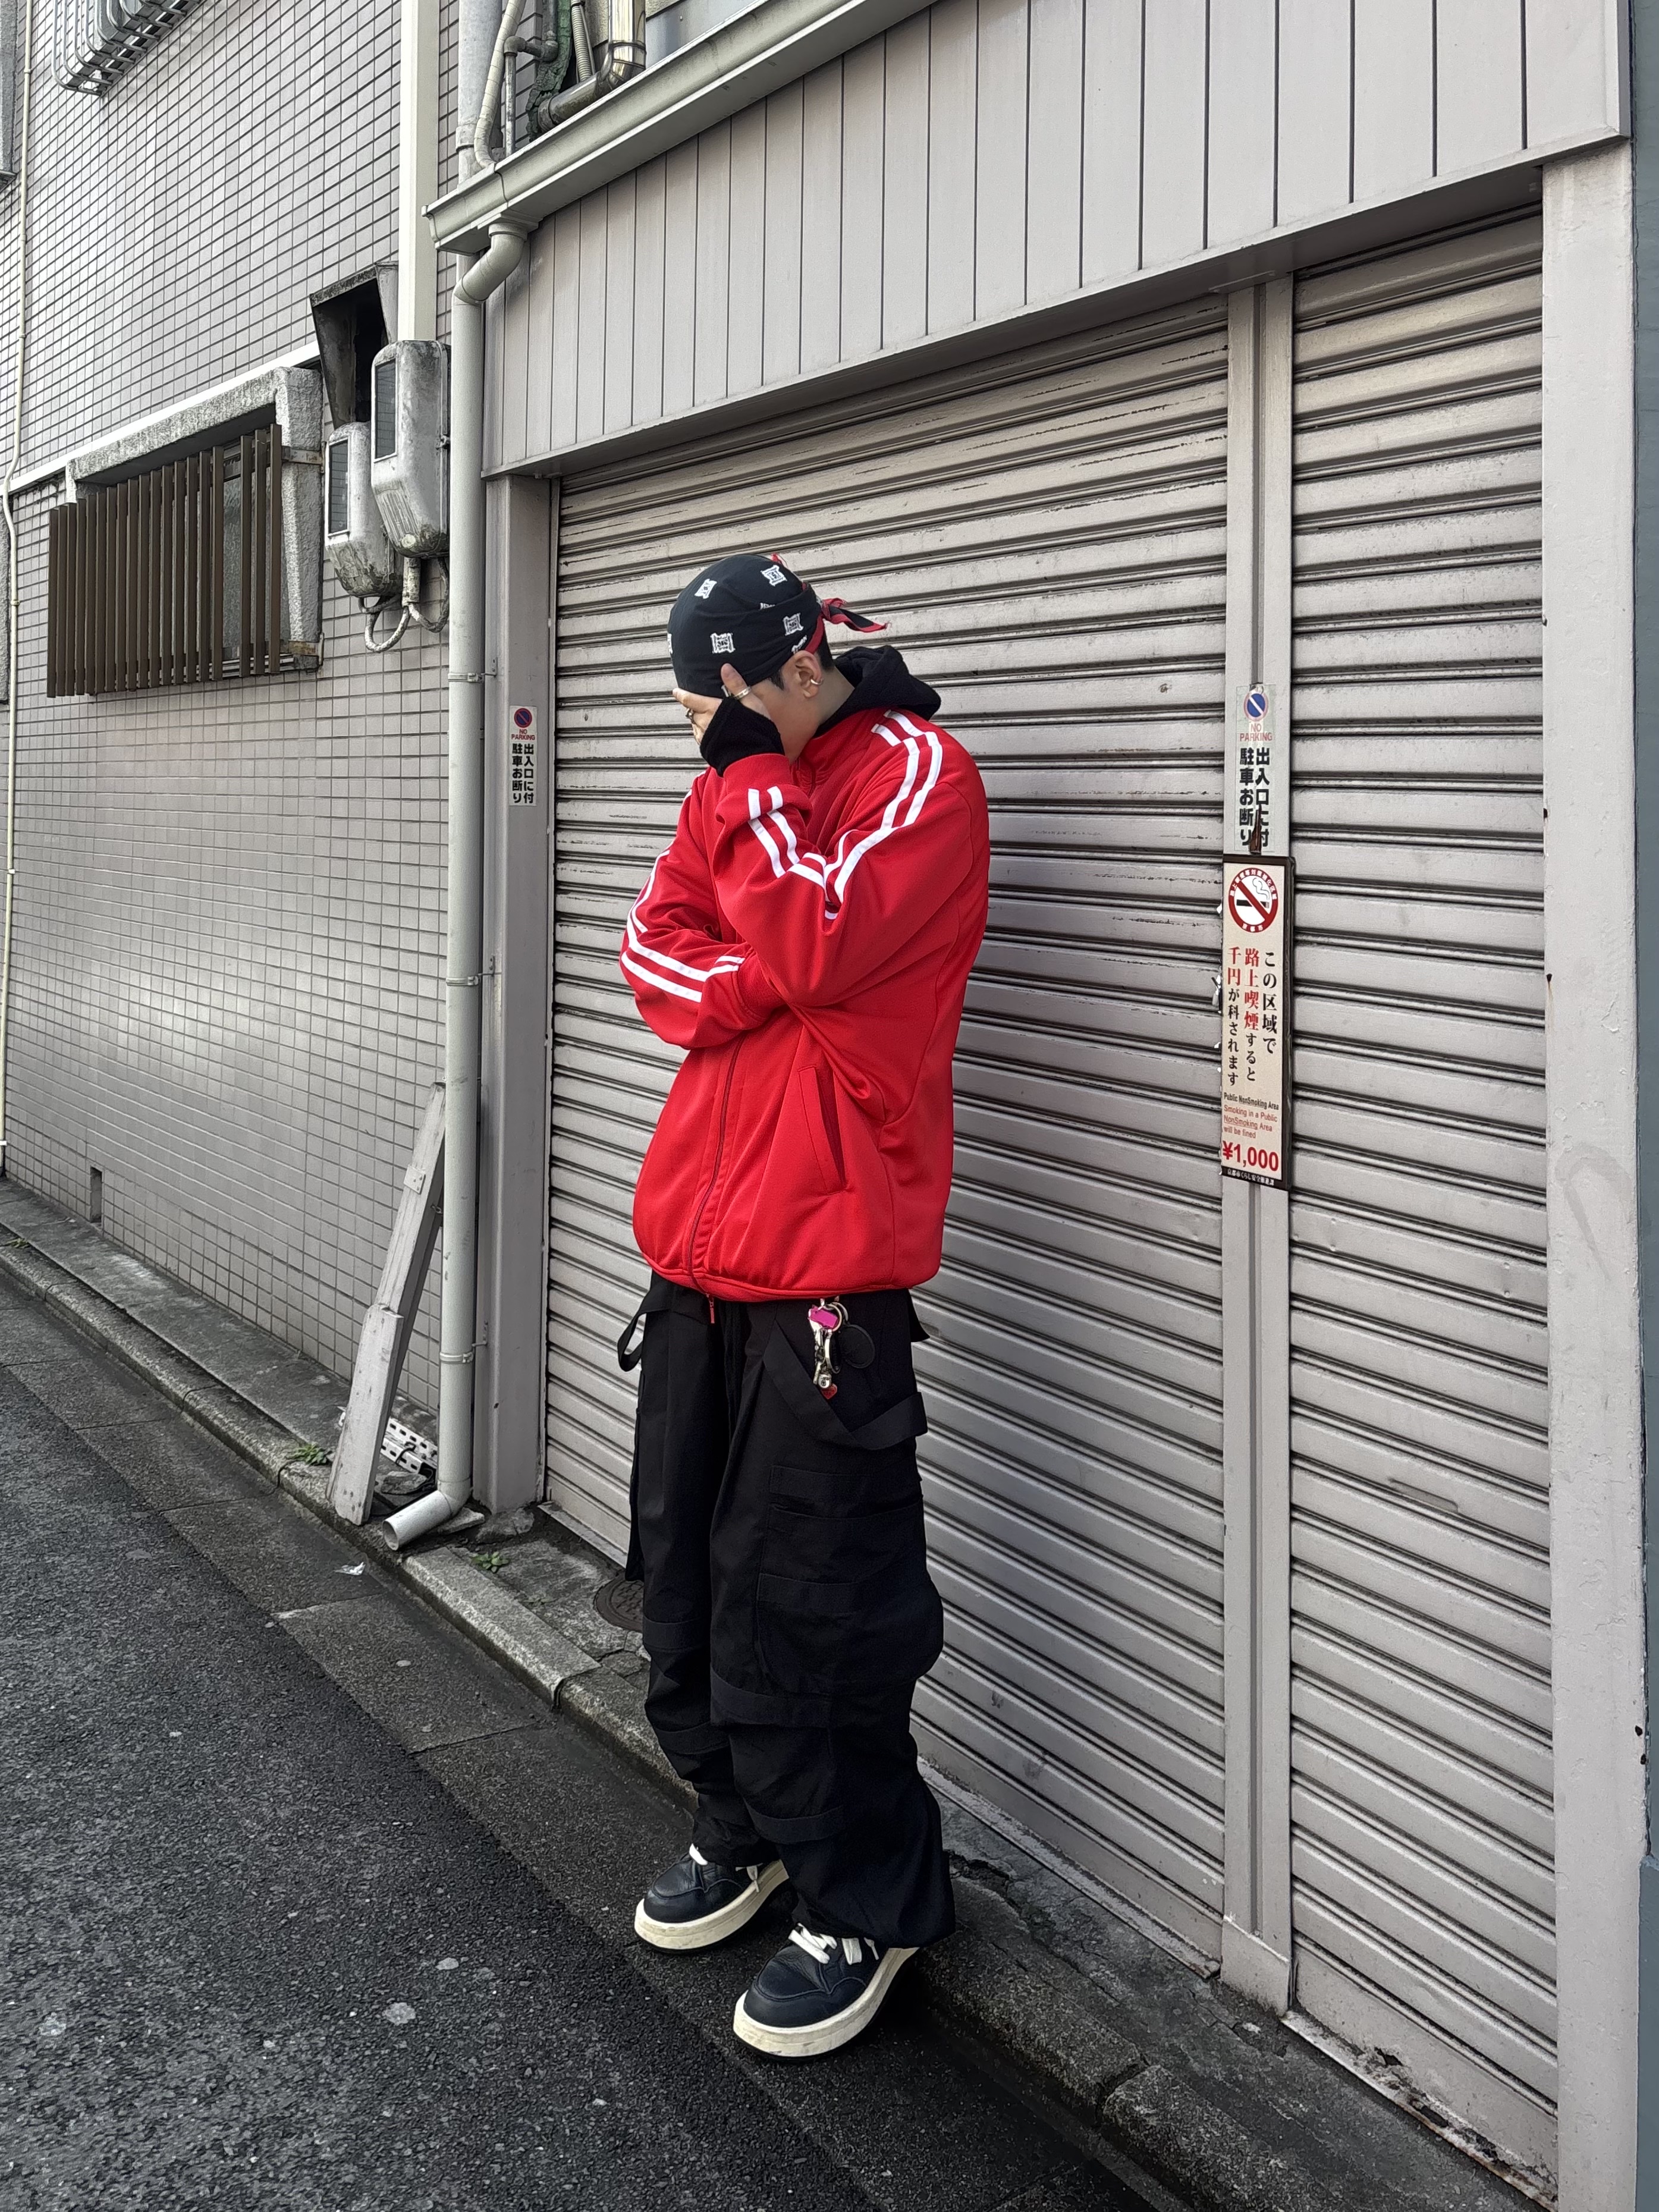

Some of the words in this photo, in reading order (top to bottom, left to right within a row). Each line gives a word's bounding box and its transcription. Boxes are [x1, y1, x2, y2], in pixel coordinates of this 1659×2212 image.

[1240, 732, 1272, 741] PARKING
[1250, 724, 1261, 732] NO
[512, 743, 523, 803] 駐車お断り
[524, 743, 534, 803] 出入口に付
[1239, 747, 1254, 846] 駐車お断り
[1227, 946, 1242, 1086] 千円が科されます
[1244, 948, 1259, 1082] 路上喫煙すると
[1262, 951, 1277, 1054] この区域で
[1224, 1092, 1238, 1102] Public
[1239, 1095, 1267, 1110] NonSmoking
[1268, 1101, 1279, 1110] Area
[1224, 1105, 1247, 1117] Smoking
[1261, 1112, 1278, 1122] Public
[1224, 1115, 1258, 1130] NonSmoking
[1259, 1123, 1272, 1132] Area
[1242, 1129, 1256, 1139] fined
[1223, 1140, 1278, 1171] ¥1,000
